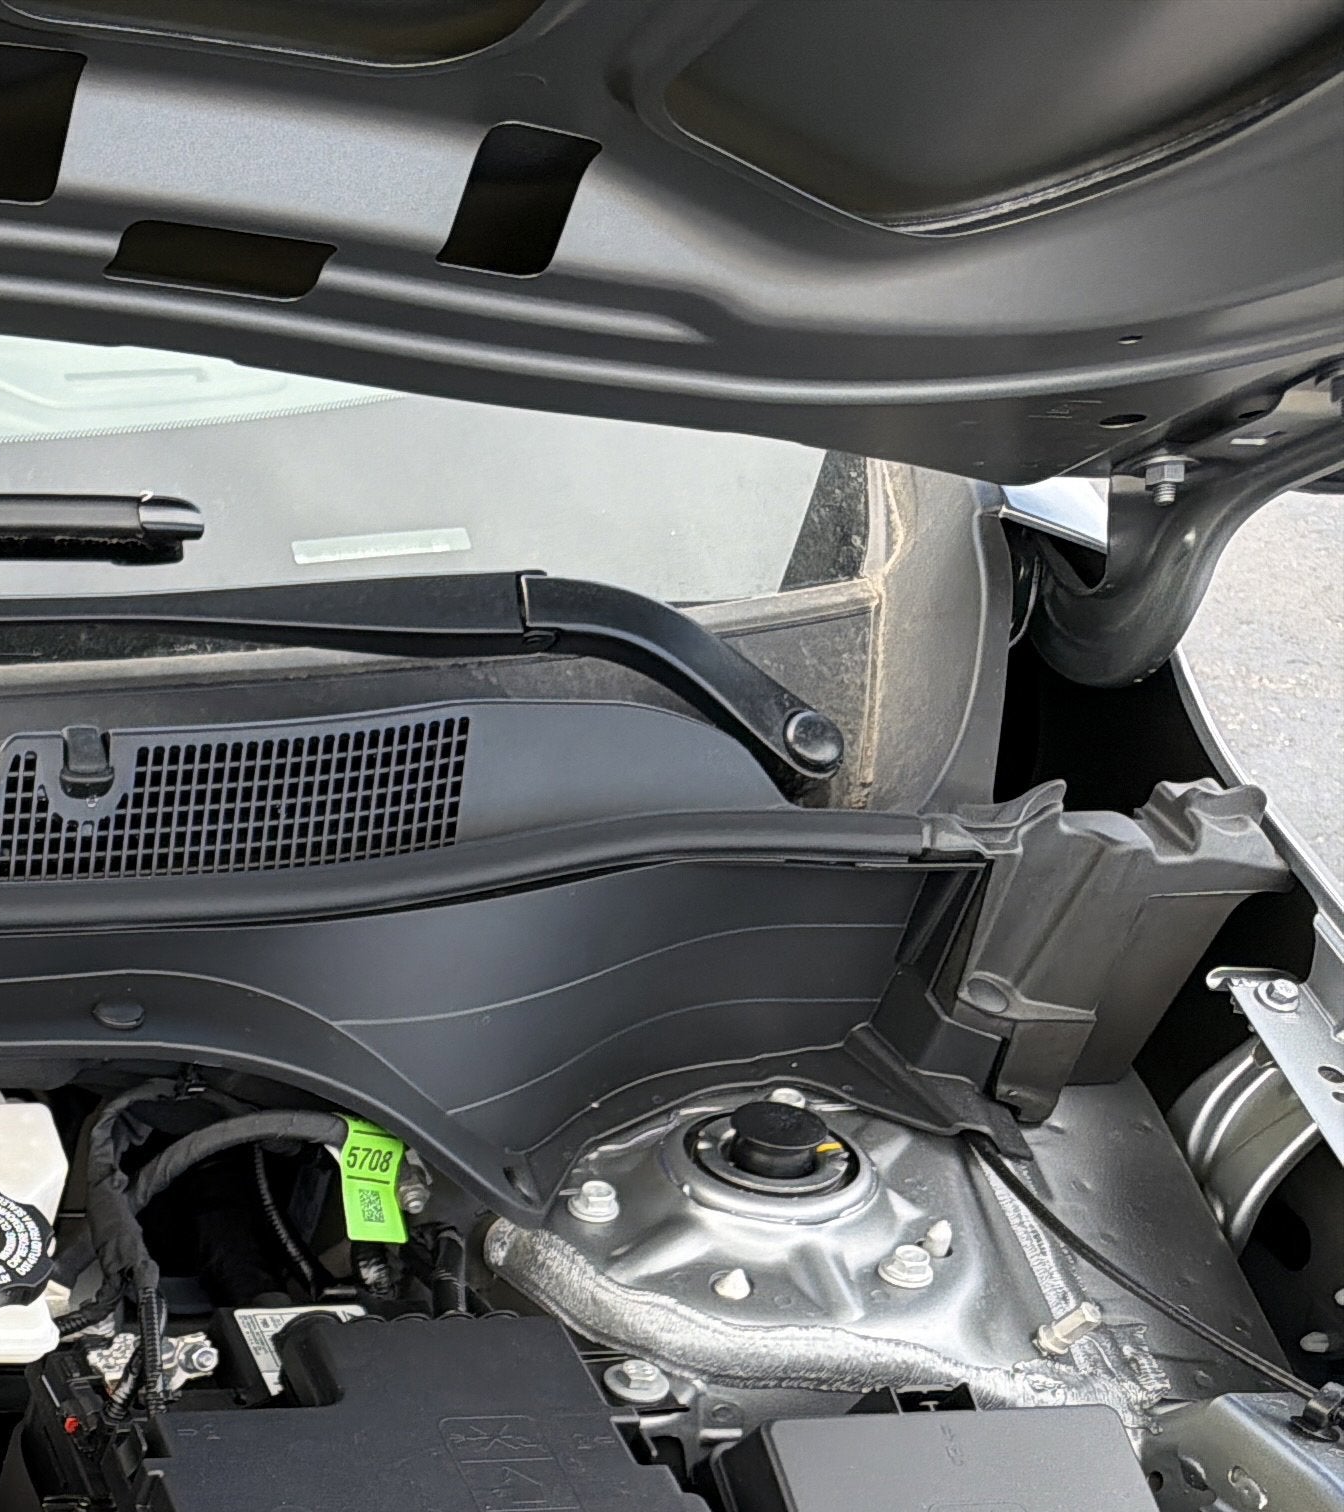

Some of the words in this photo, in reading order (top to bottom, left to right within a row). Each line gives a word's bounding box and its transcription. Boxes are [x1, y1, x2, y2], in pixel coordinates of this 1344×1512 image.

[346, 1145, 394, 1173] 5708
[19, 1214, 32, 1222] A
[23, 1220, 41, 1240] FROM
[13, 1259, 34, 1276] DOT
